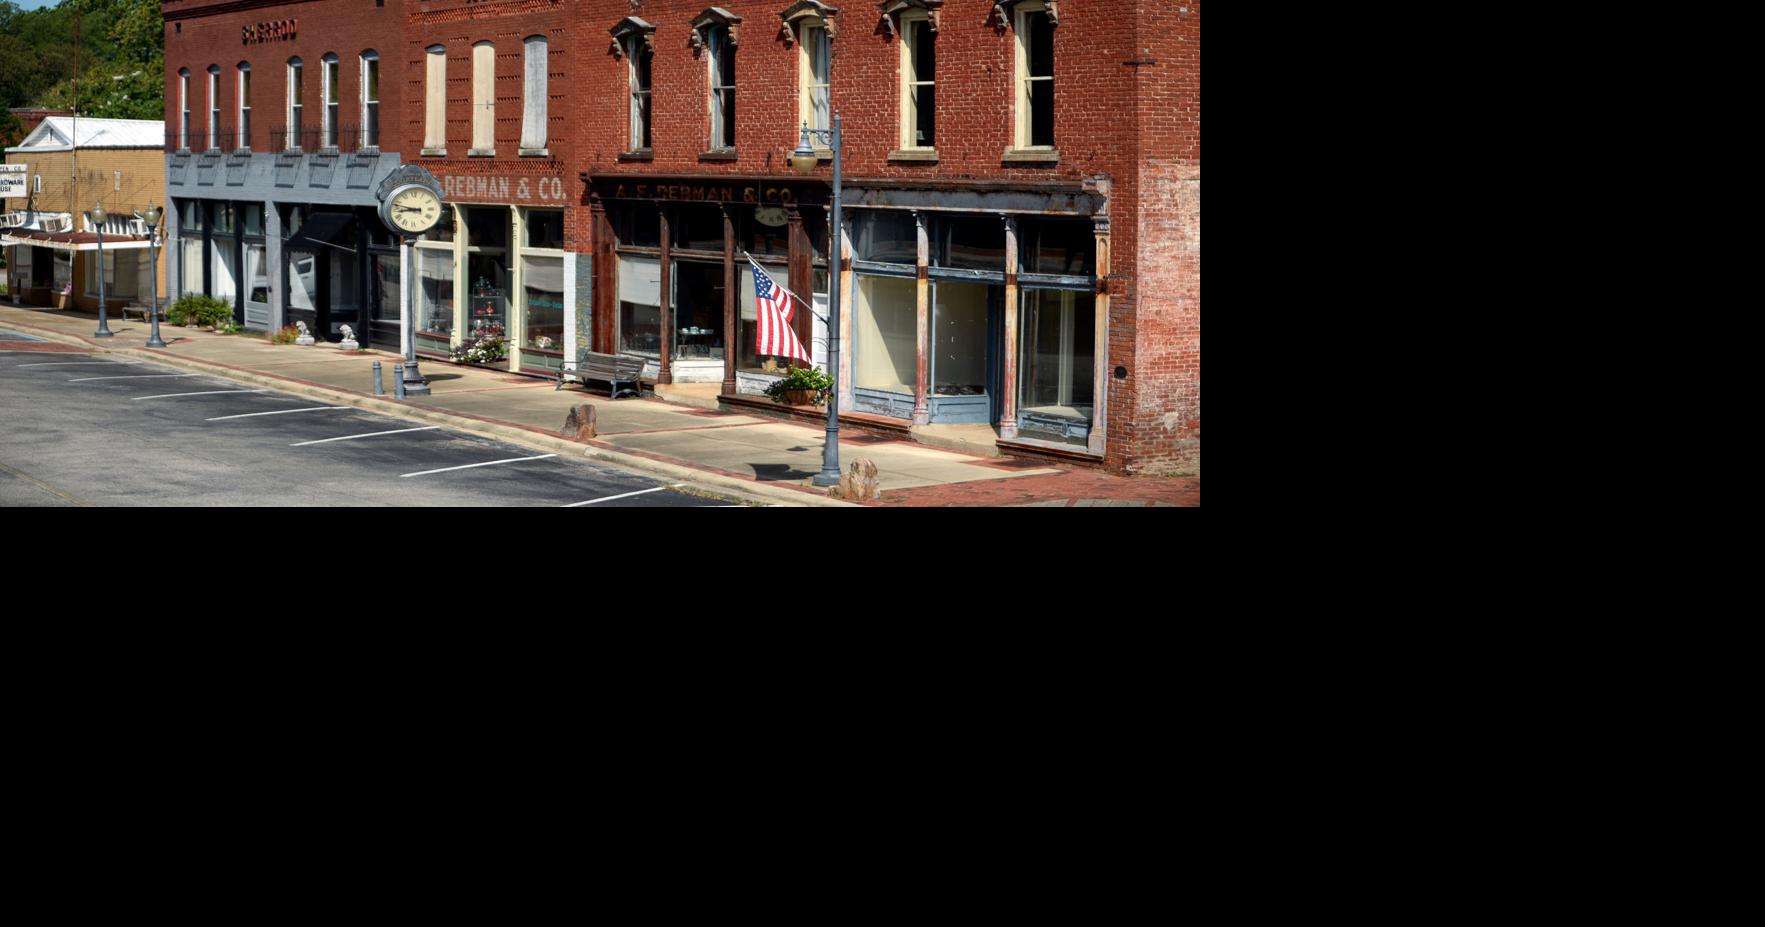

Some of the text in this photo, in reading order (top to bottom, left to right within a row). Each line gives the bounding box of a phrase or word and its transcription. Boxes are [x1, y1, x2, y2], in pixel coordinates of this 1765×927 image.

[242, 19, 297, 41] SHERROD
[445, 175, 567, 200] REBMAN & CO.
[743, 187, 758, 202] &
